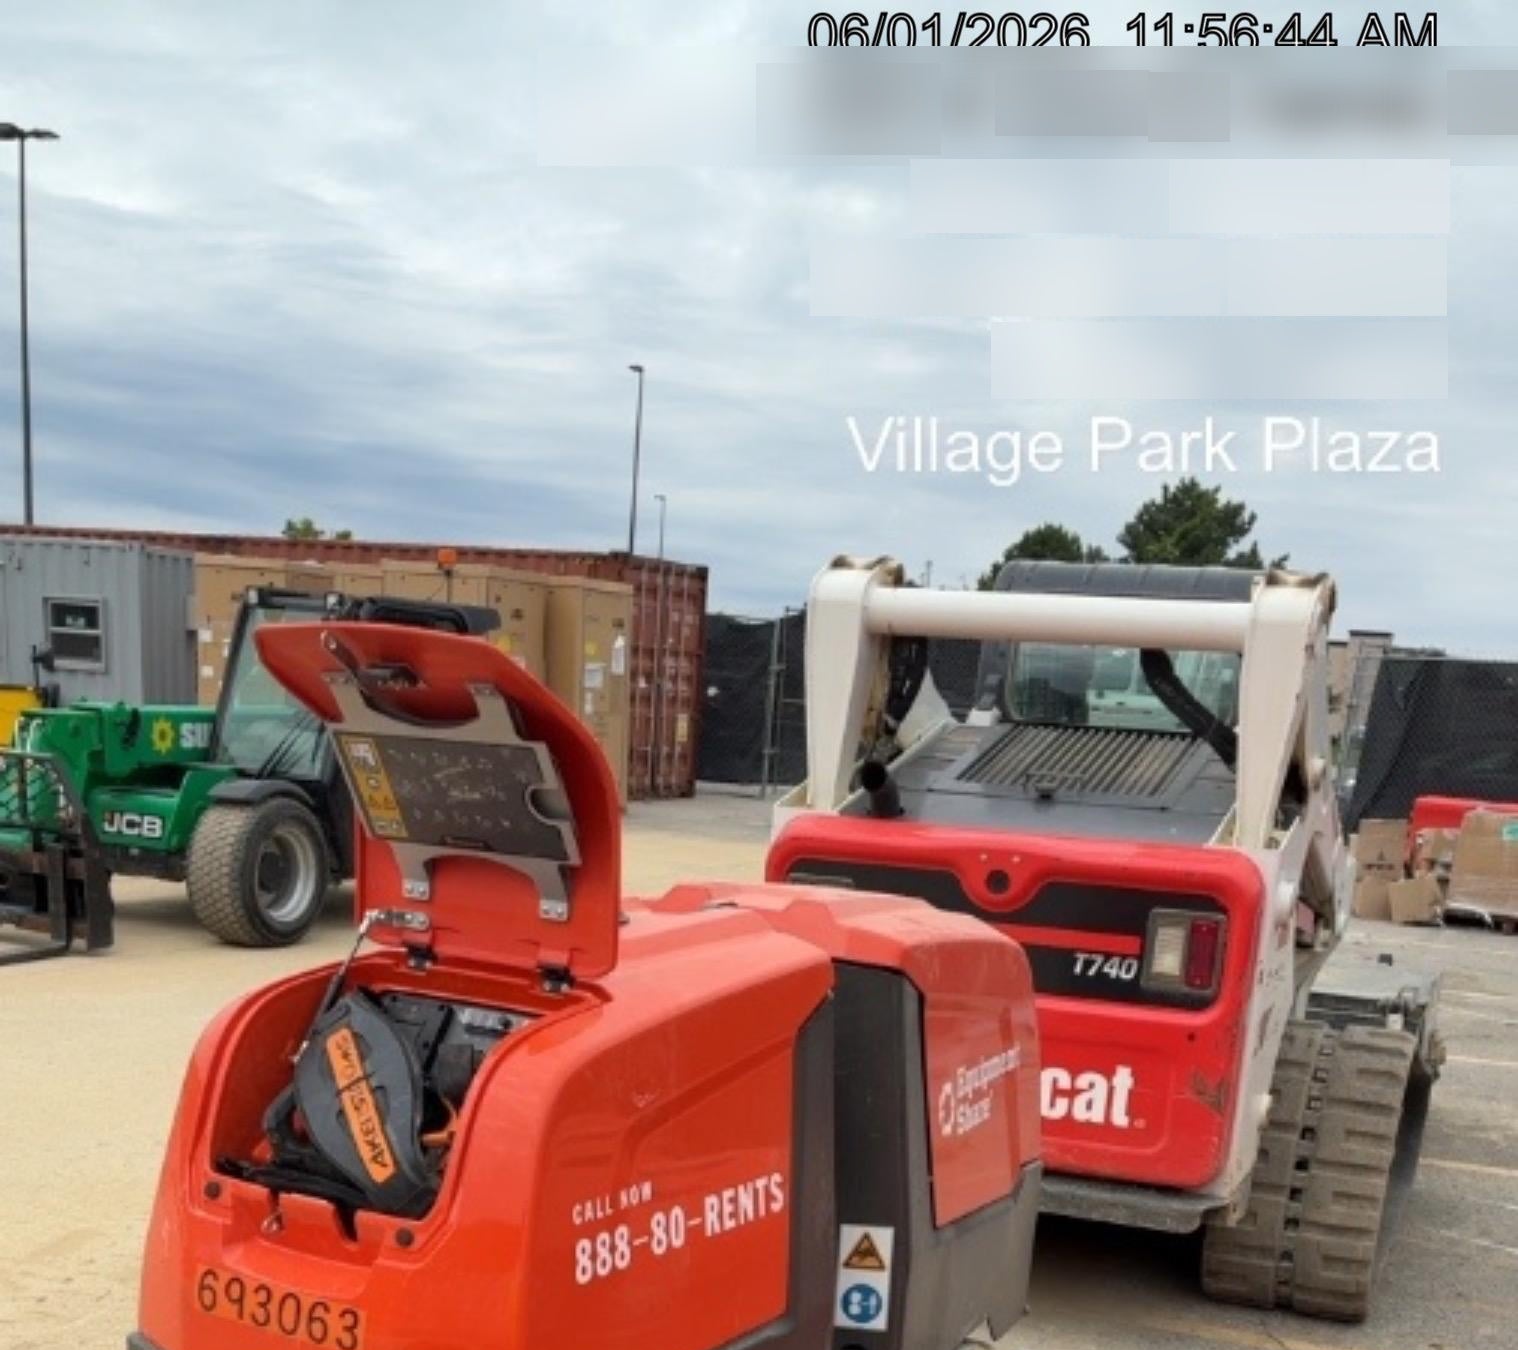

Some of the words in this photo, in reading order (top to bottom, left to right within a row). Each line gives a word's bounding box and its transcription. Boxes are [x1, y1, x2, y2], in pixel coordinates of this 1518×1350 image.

[103, 812, 163, 837] JCB
[1073, 952, 1138, 980] T740
[572, 1195, 613, 1226] CALL
[620, 1180, 652, 1210] NOW
[575, 1172, 784, 1285] 888-80-RENTS
